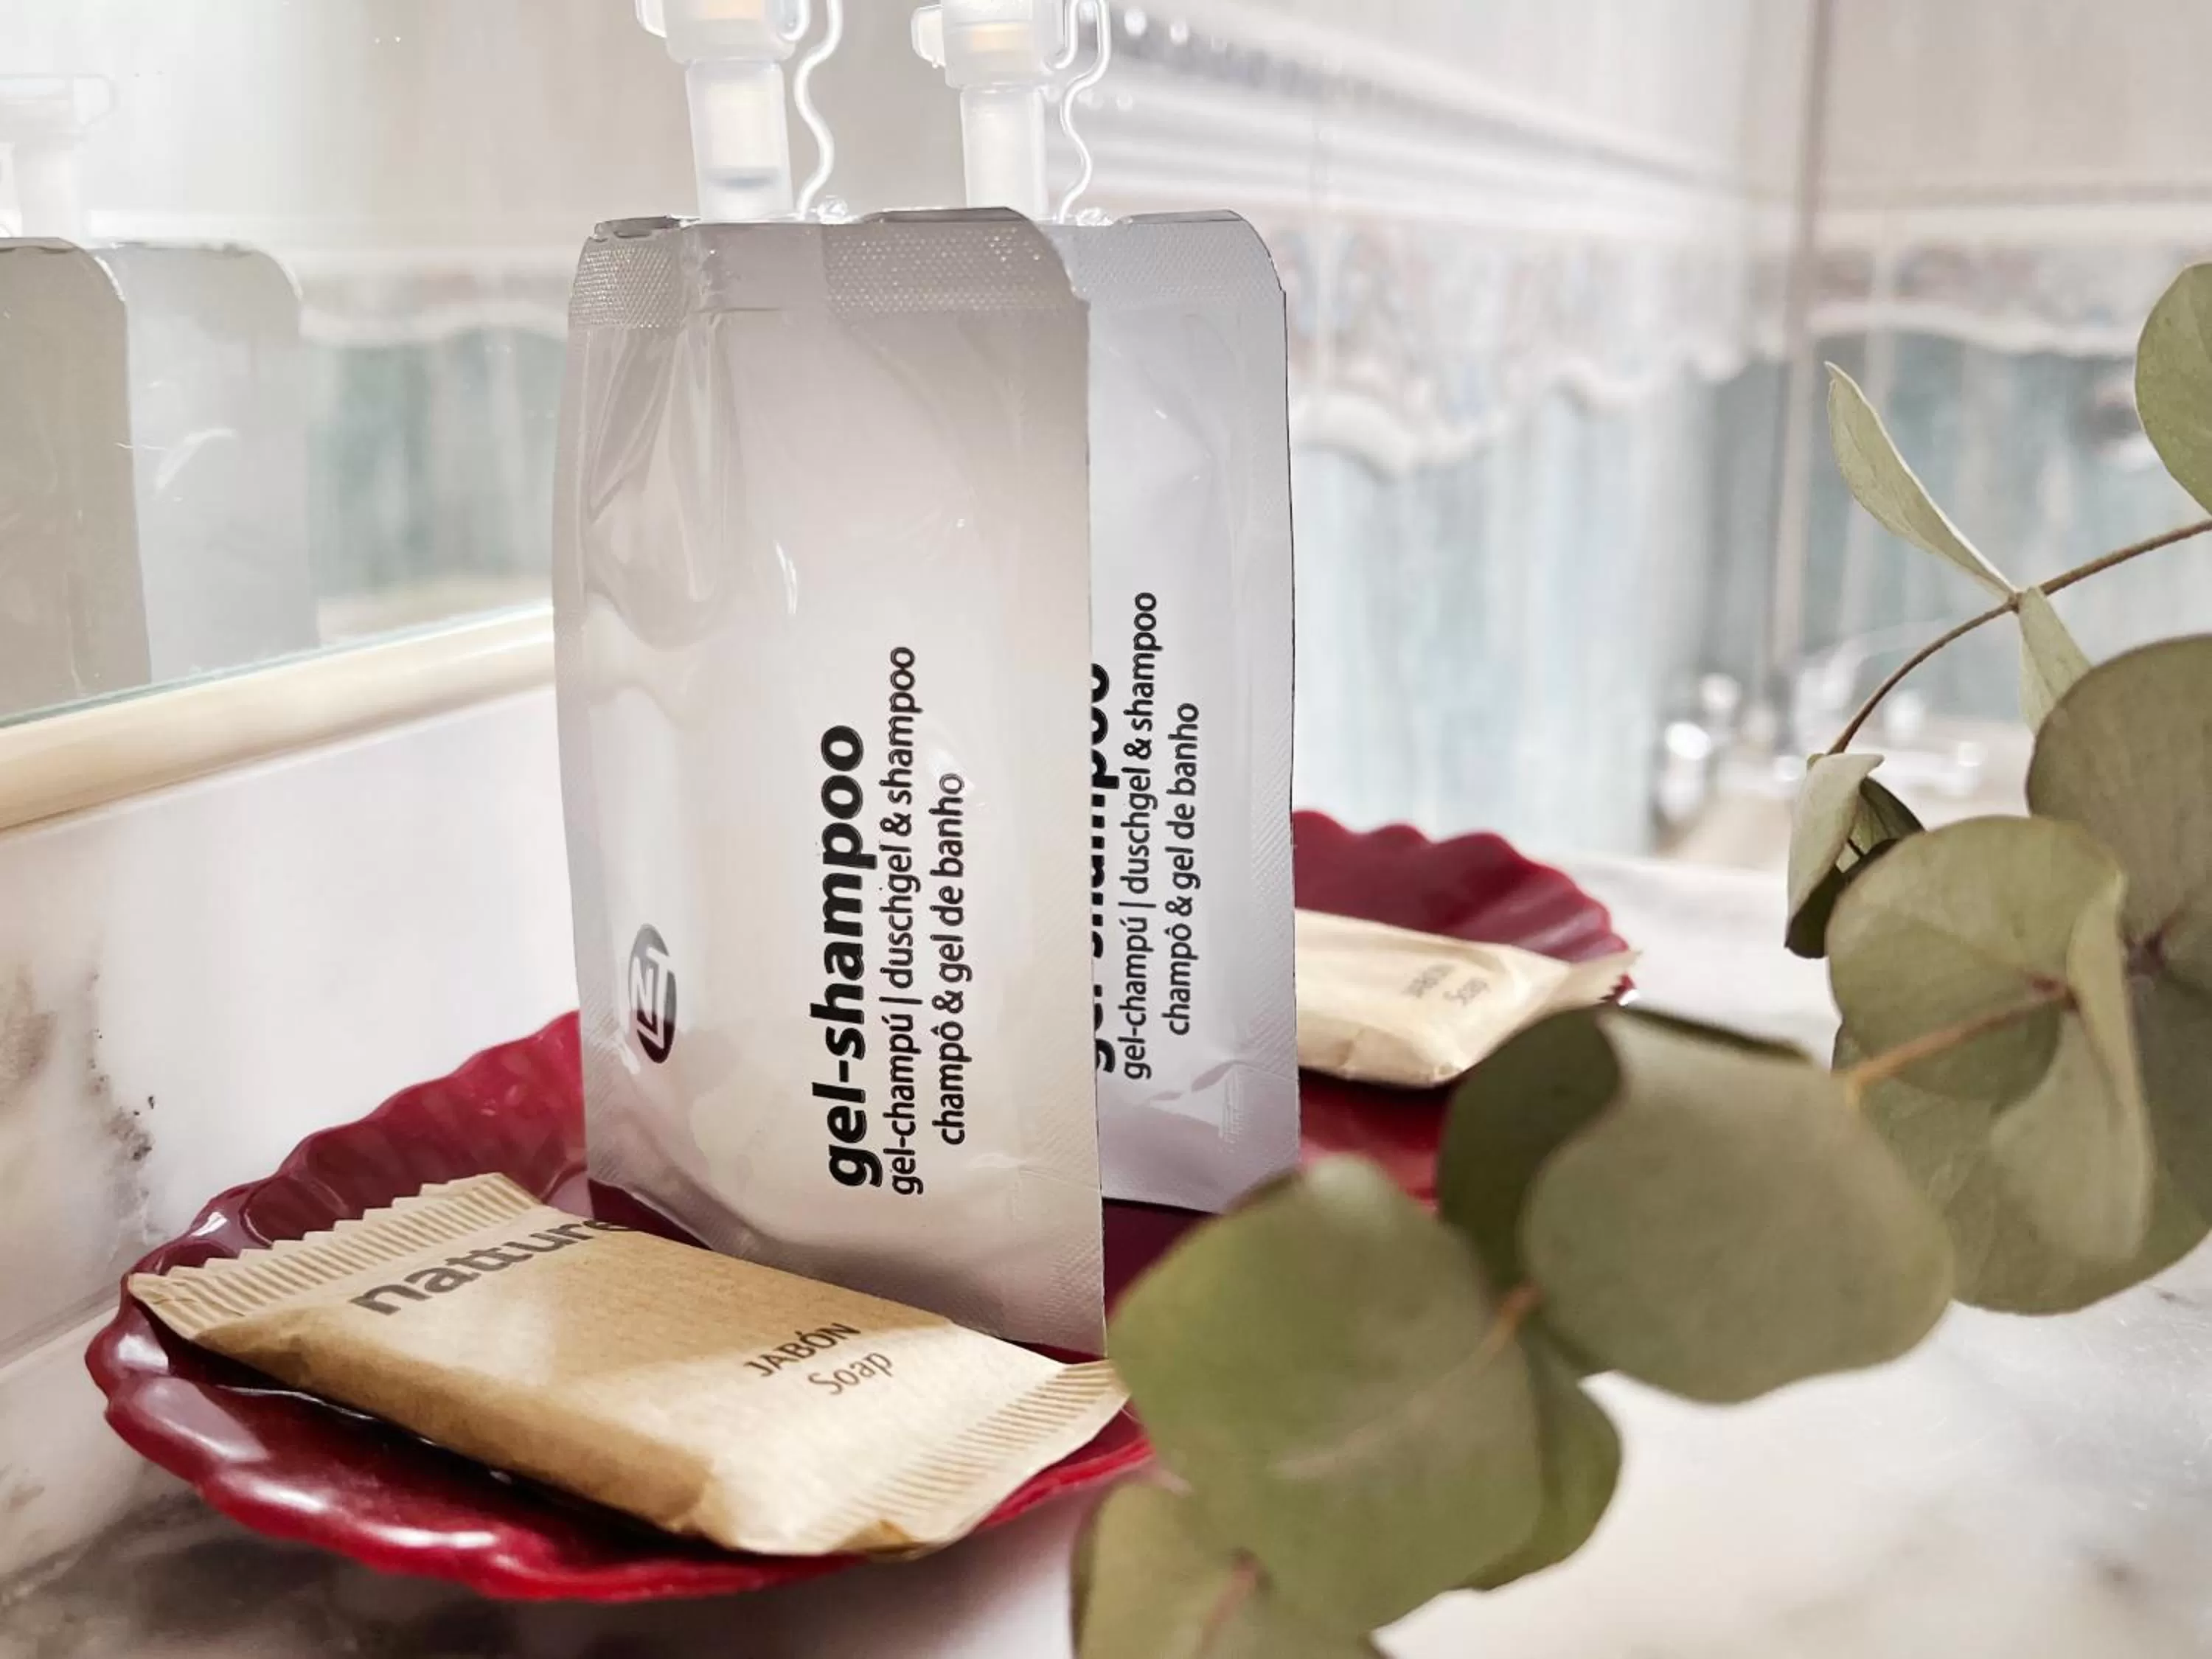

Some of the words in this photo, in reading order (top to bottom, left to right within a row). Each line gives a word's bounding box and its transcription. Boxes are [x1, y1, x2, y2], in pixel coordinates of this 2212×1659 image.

[1123, 592, 1163, 732] shampoo
[878, 647, 922, 805] shampoo
[1123, 737, 1153, 760] &
[1166, 703, 1200, 796] banho
[879, 812, 912, 837] &
[928, 773, 964, 878] banho
[1119, 766, 1158, 894] duschgel
[1164, 846, 1201, 890] gel
[1166, 803, 1196, 840] de
[879, 844, 921, 989] duschgel
[929, 886, 964, 927] de
[1165, 896, 1193, 917] &
[809, 725, 883, 1188] gel-shampoo
[930, 934, 973, 983] gel
[931, 990, 964, 1015] &
[1117, 917, 1155, 1080] gel-champú
[1161, 922, 1198, 1036] champô
[882, 1013, 924, 1195] gel-champú
[930, 1020, 973, 1145] champô
[743, 1322, 861, 1377] JABÓN
[808, 1352, 894, 1395] Soap
